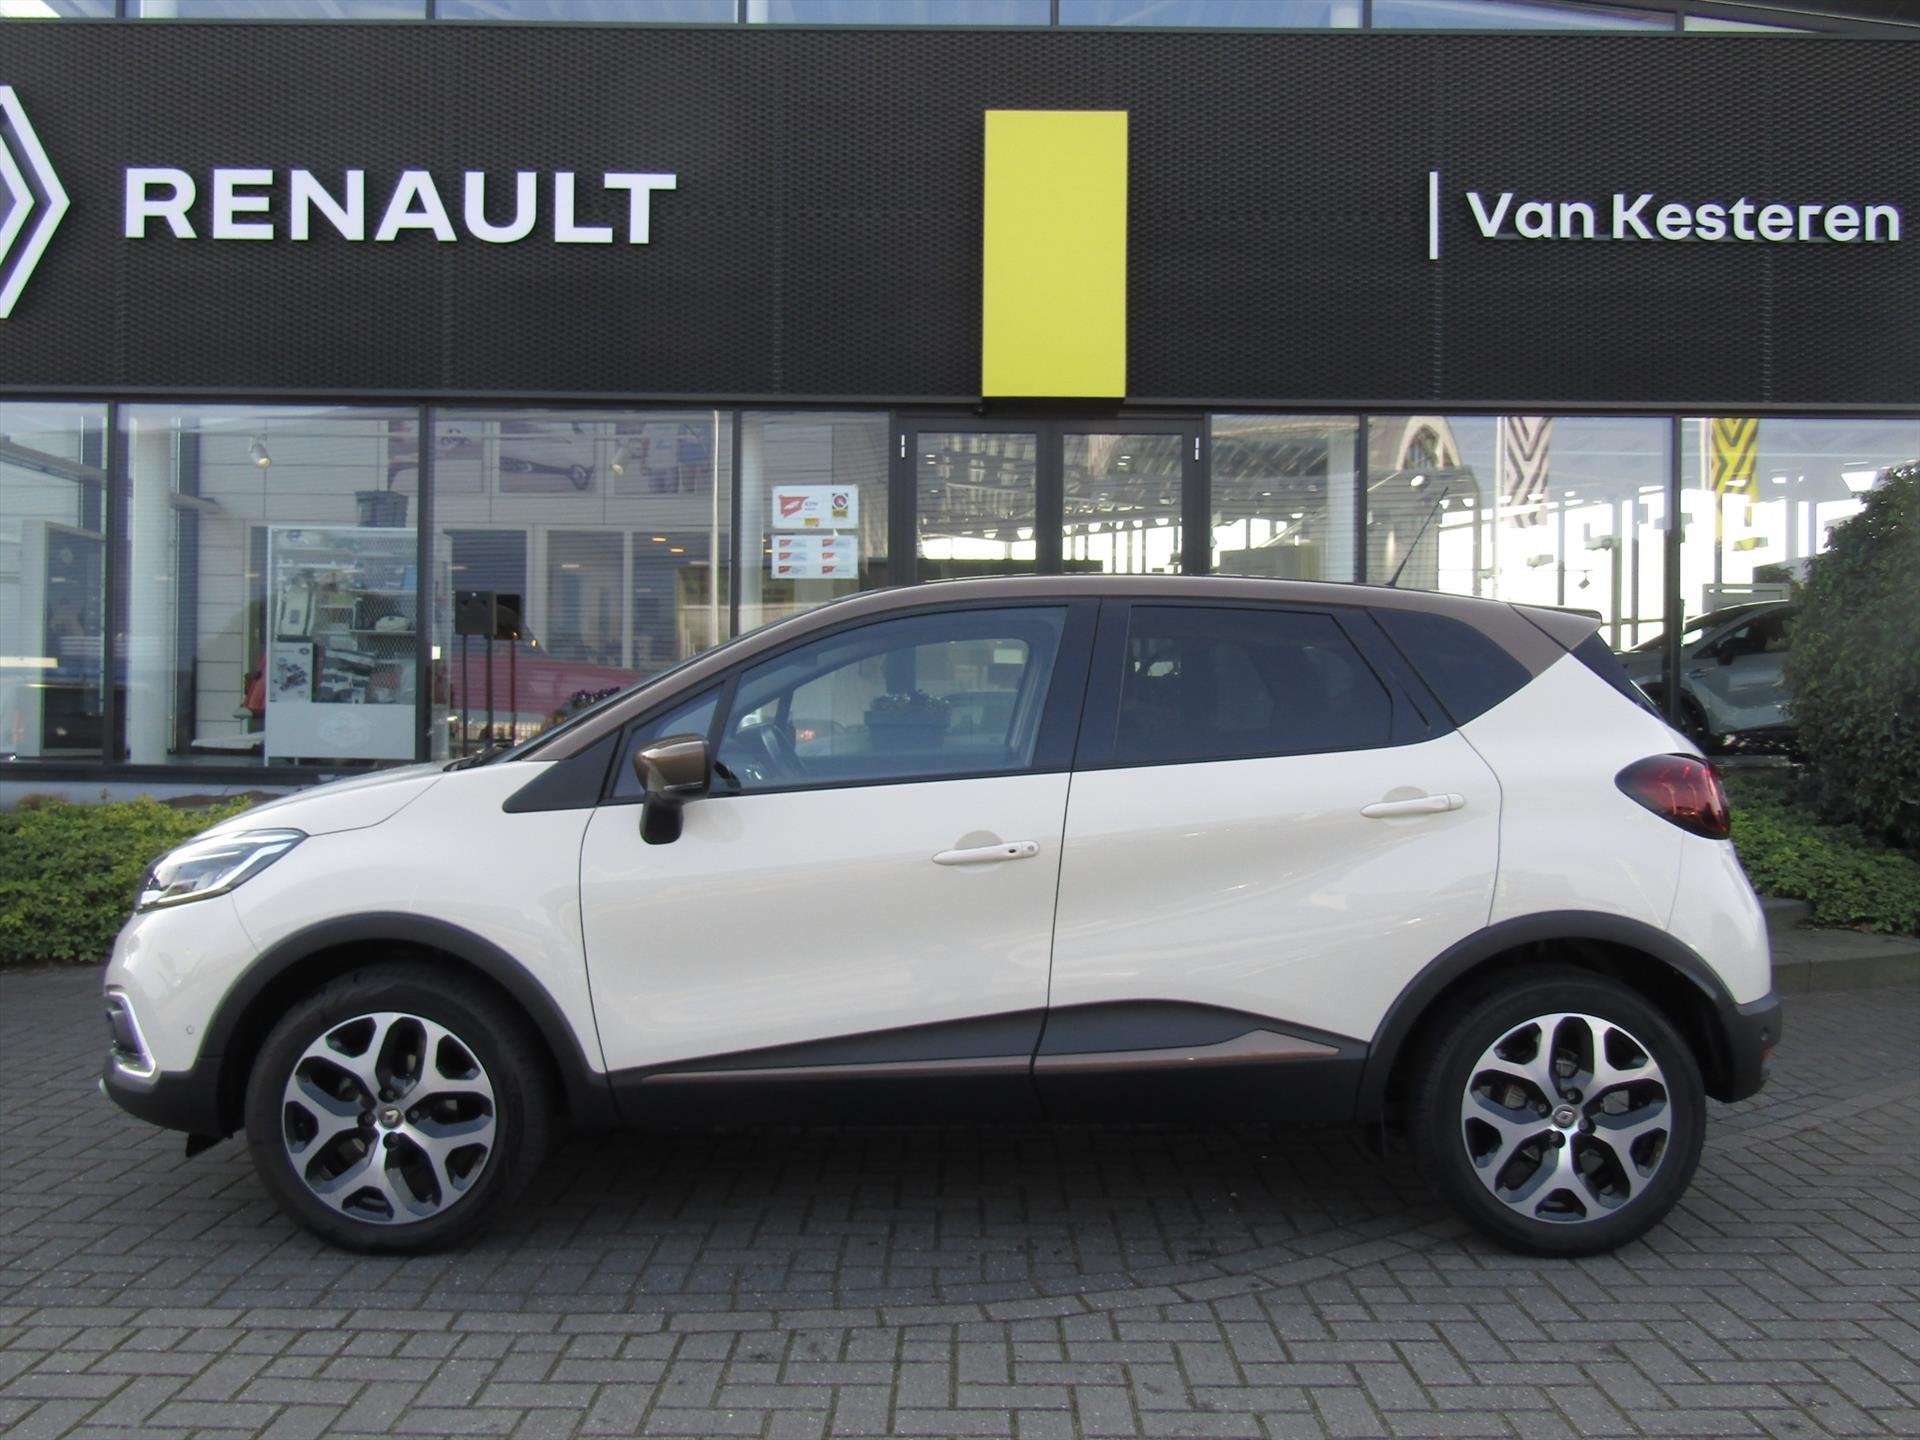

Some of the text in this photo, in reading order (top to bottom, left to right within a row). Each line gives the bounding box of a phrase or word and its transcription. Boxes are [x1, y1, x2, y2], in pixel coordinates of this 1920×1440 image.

[125, 167, 677, 244] RENAULT
[1466, 192, 1900, 242] Van Kesteren
